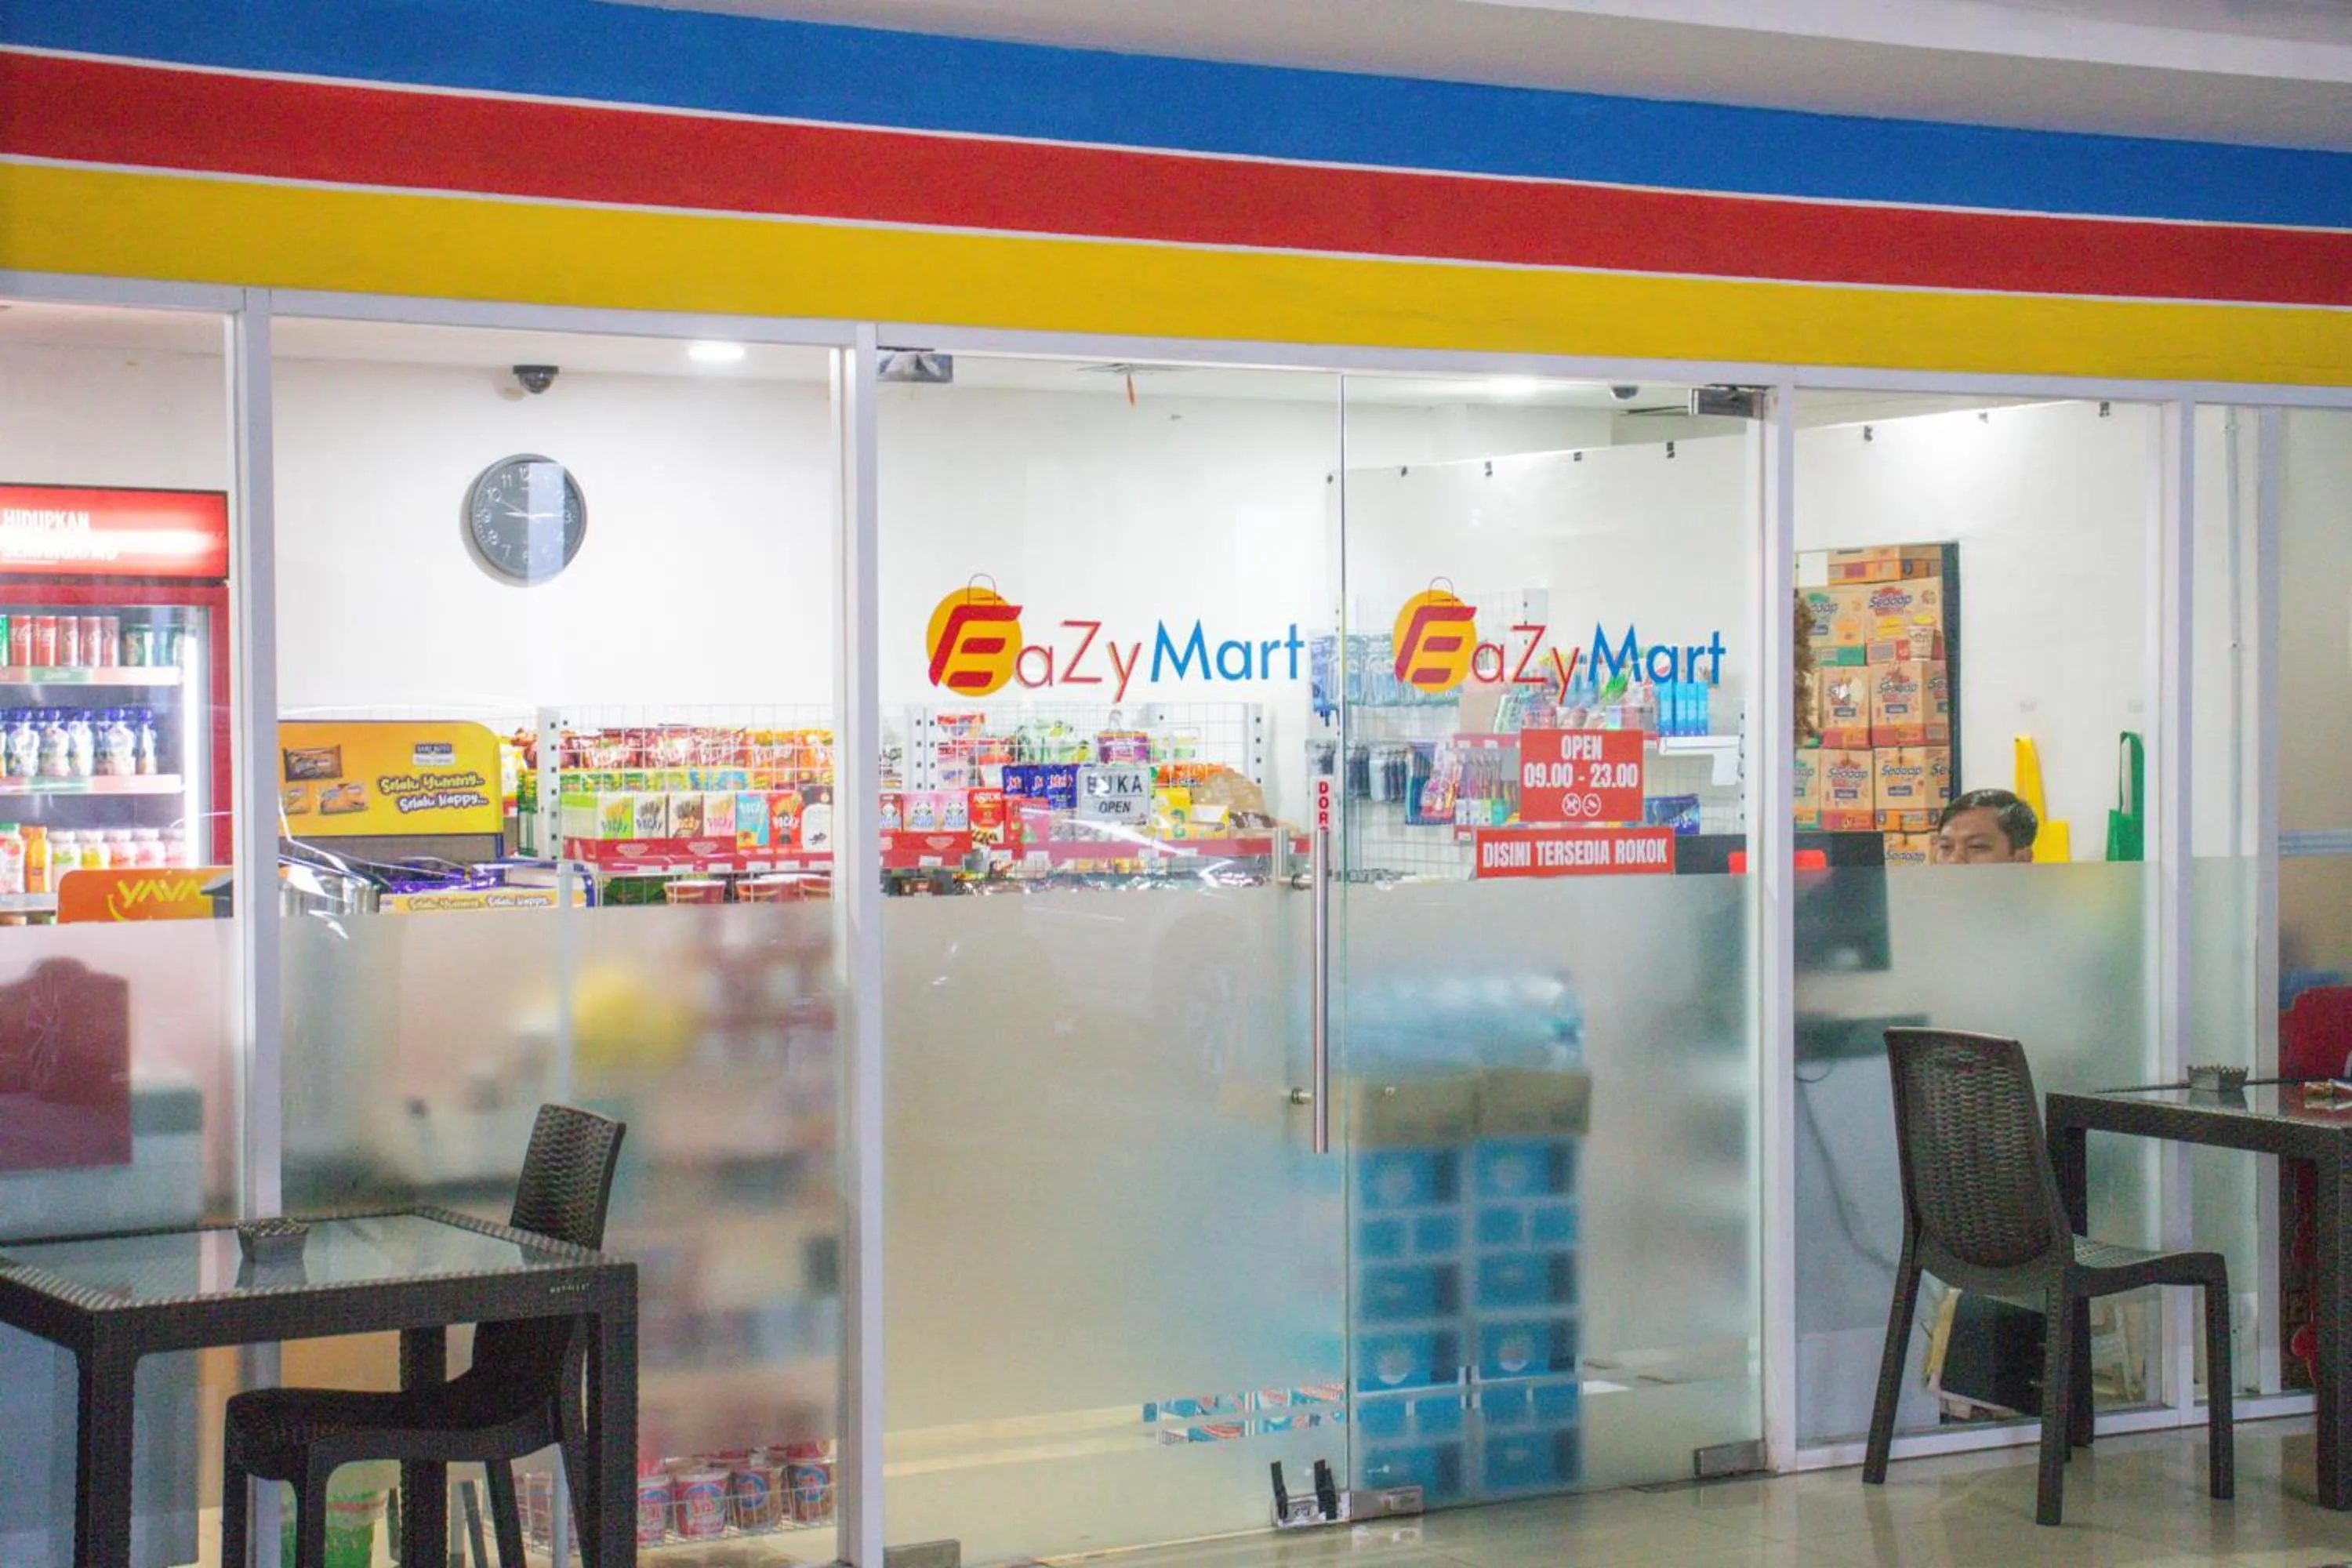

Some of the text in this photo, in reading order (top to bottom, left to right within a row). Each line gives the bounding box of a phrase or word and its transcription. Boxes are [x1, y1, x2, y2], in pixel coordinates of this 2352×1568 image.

[1560, 734, 1603, 760] OPEN
[1087, 775, 1142, 794] BUKA
[1523, 762, 1573, 788] 09.00
[1589, 762, 1639, 788] 23.00
[1098, 800, 1132, 813] OPEN
[1483, 837, 1668, 868] DISINI TERSEDIA ROKOK
